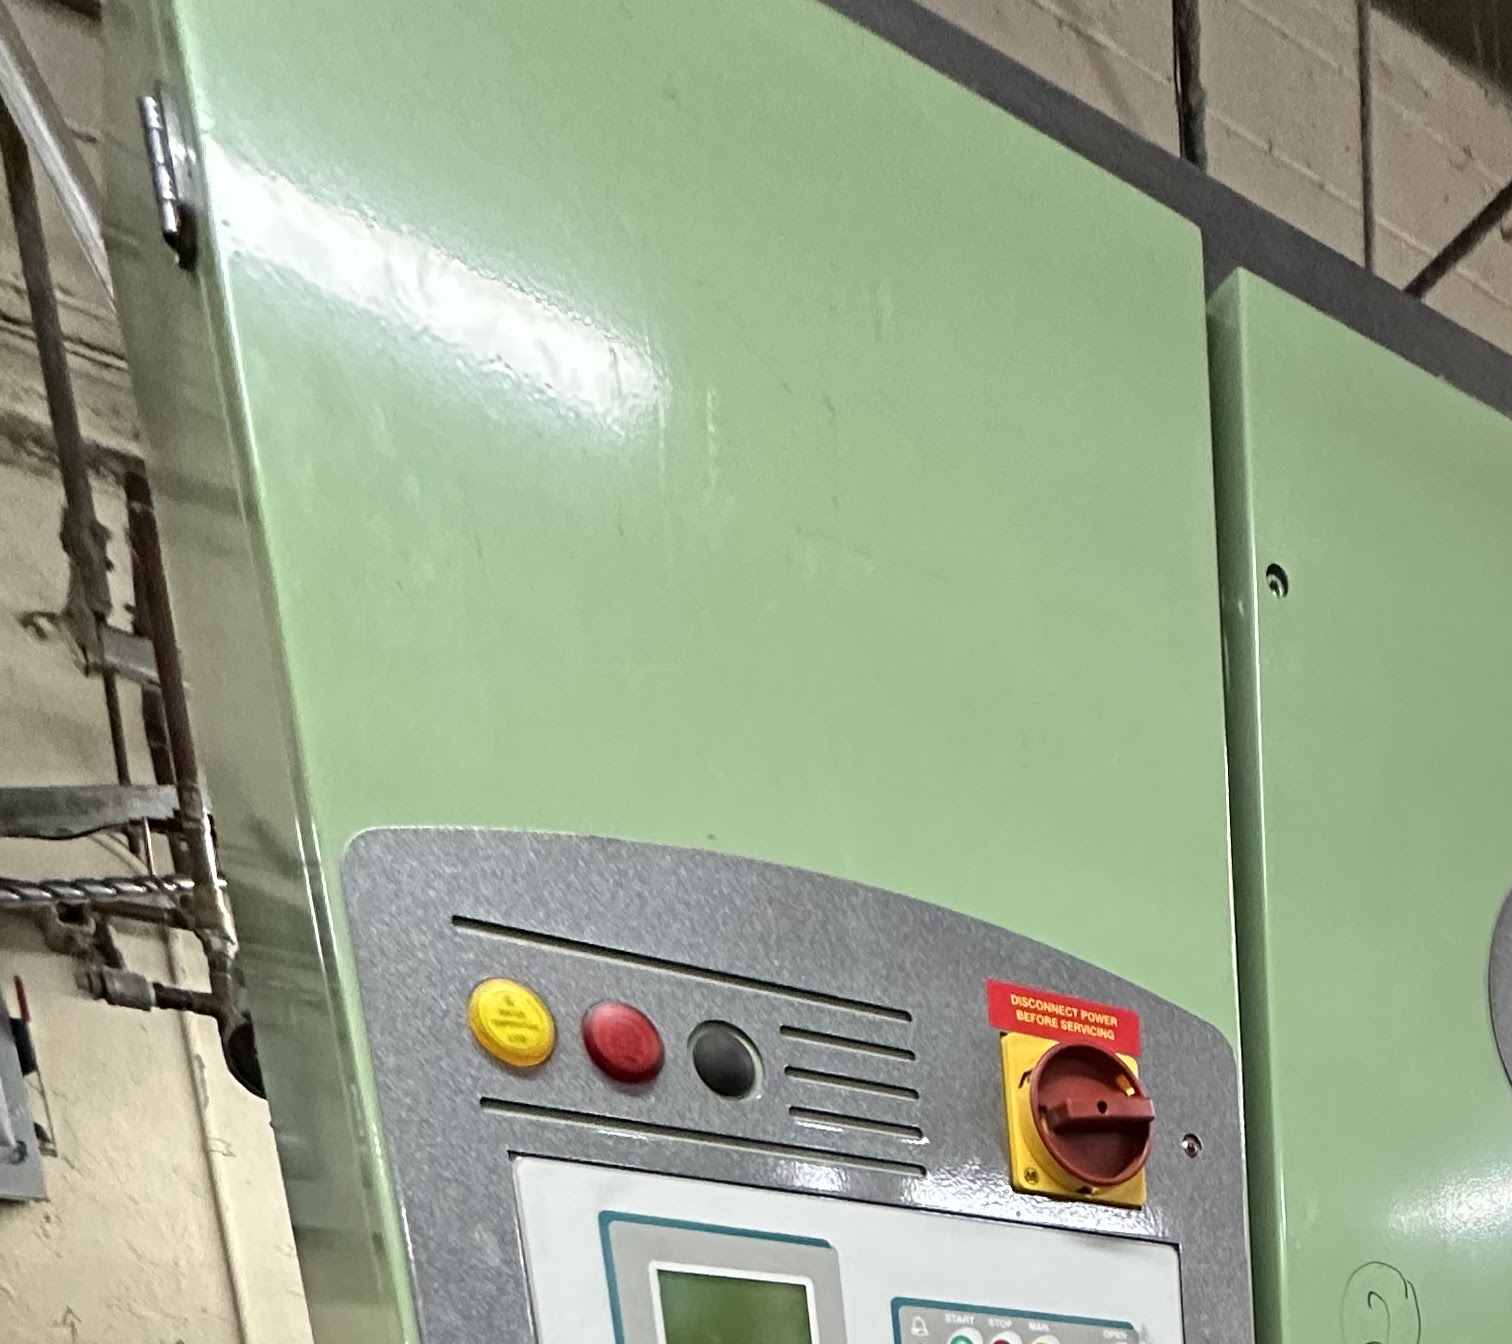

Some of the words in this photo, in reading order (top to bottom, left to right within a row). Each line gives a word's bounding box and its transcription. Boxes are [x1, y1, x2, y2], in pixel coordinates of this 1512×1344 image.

[1010, 993, 1078, 1018] DISCONNECT
[1080, 1009, 1118, 1027] POWER
[1016, 1009, 1058, 1029] BEFORE
[1061, 1020, 1115, 1041] SERVICING
[945, 1313, 975, 1325] START
[988, 1318, 1013, 1329] STOP
[1103, 1329, 1128, 1340] OPEN
